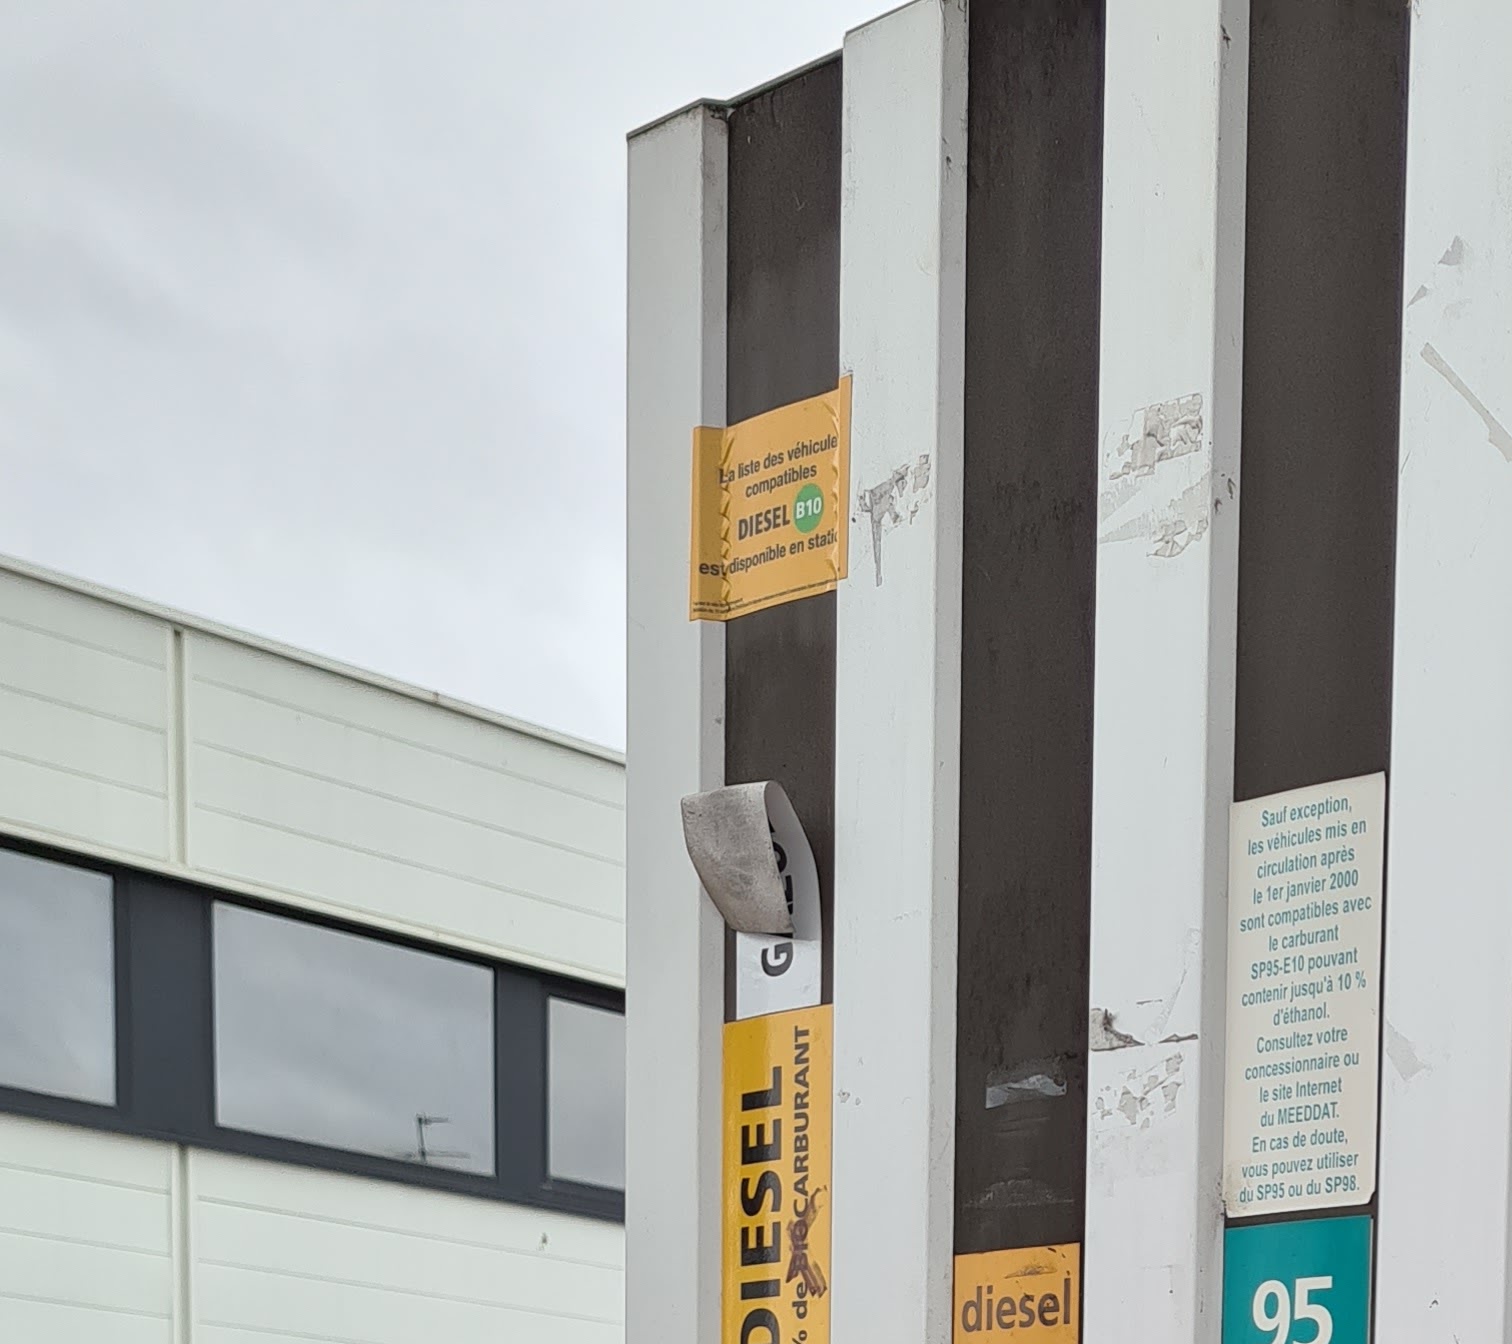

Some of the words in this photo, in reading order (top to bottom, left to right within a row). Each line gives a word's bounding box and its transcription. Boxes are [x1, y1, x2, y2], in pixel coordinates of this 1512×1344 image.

[738, 460, 760, 479] liste
[745, 465, 817, 498] compatibles
[738, 504, 790, 541] DIESEL
[796, 497, 822, 519] B10
[729, 544, 786, 574] disponible
[1261, 806, 1287, 827] Sauf
[1267, 826, 1322, 851] véhicules
[1257, 853, 1317, 879] circulation
[1285, 876, 1327, 905] janvier
[1329, 869, 1358, 890] 2000
[1268, 900, 1339, 927] compatibles
[1282, 924, 1339, 949] carburant
[1251, 955, 1304, 980] SP95-E10
[1308, 947, 1358, 974] pouvant
[1242, 983, 1288, 1007] contenir
[1257, 1032, 1313, 1054] Consultez
[1316, 1027, 1348, 1044] votre
[1245, 1052, 1340, 1080] concessionnaire
[1296, 1077, 1342, 1097] Internet
[1310, 1128, 1348, 1146] doute,
[1272, 1158, 1313, 1179] pouvez
[1317, 1151, 1359, 1170] utiliser
[1257, 1182, 1285, 1201] SP95
[1325, 1175, 1360, 1193] SP98.
[792, 1283, 807, 1319] de
[961, 1276, 1072, 1334] diesel
